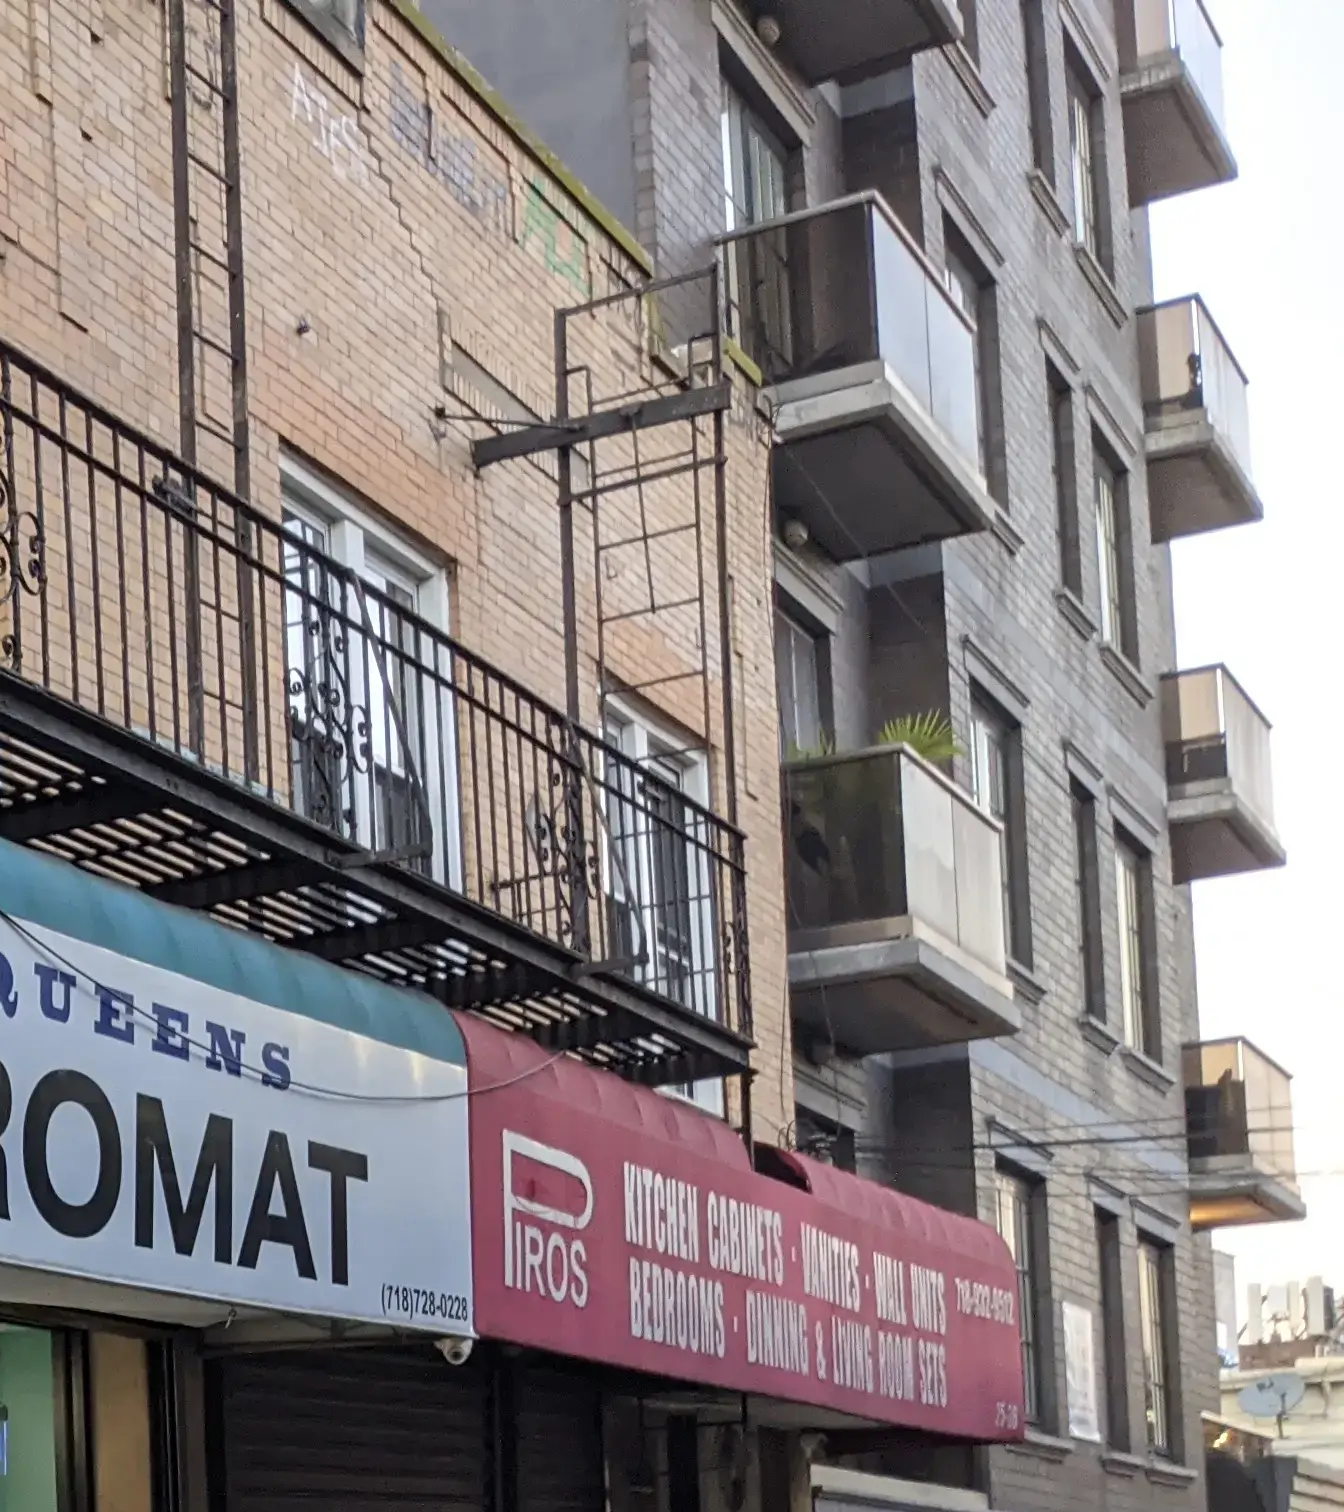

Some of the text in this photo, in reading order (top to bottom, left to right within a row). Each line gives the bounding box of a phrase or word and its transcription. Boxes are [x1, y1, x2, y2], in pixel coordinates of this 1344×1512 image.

[502, 1128, 593, 1309] PIROS
[624, 1161, 699, 1263] KITCHEN
[707, 1191, 784, 1287] CABINETS
[801, 1222, 860, 1313] VANITIES
[873, 1251, 907, 1325] WALL
[911, 1263, 946, 1336] UNITS
[381, 1282, 468, 1322] (718)728-0228
[629, 1256, 947, 1408] BEDROOMS DINNING & LIVING ROOM SETS
